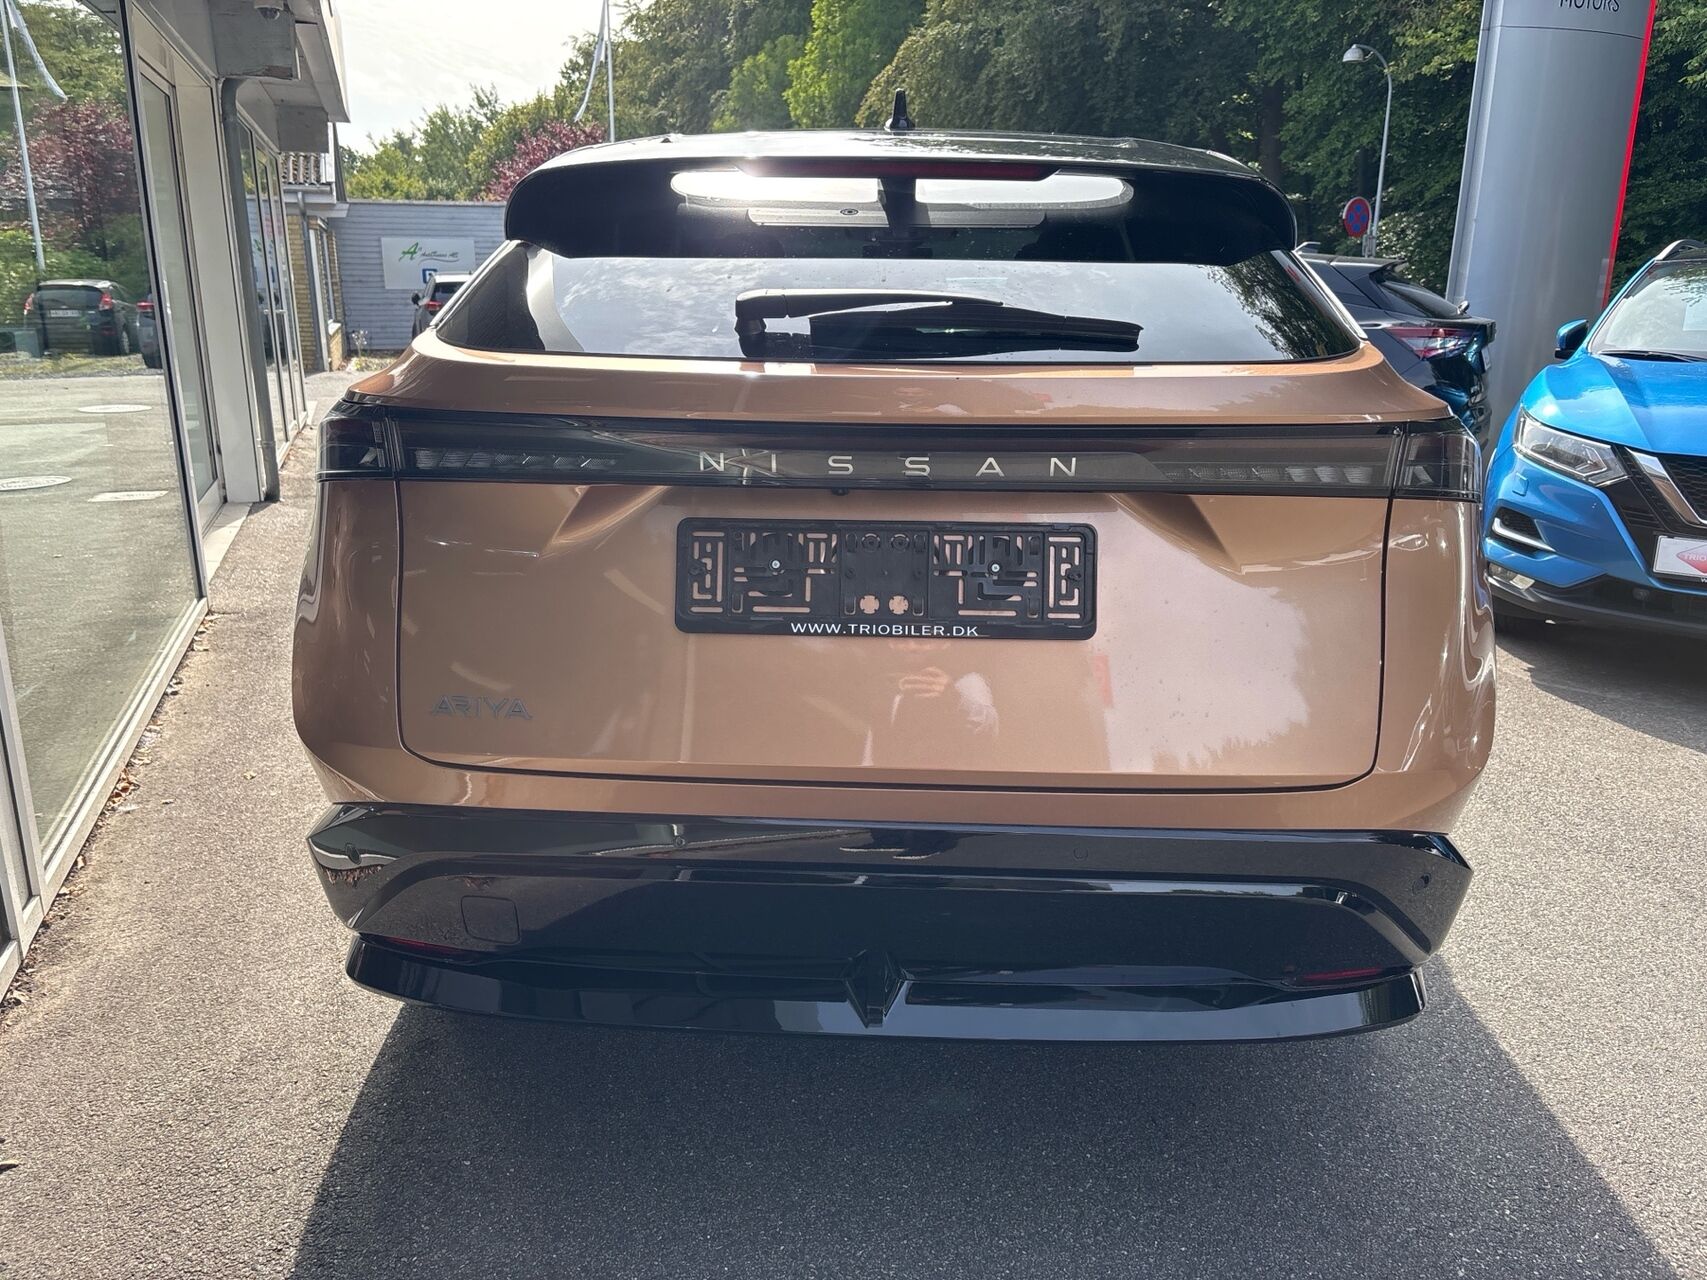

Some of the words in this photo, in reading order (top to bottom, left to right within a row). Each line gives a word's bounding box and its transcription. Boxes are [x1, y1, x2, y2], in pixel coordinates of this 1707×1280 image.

[700, 451, 1077, 477] NISSAN
[790, 622, 979, 637] WWW.TRIOBILER.DK
[432, 695, 533, 720] ARIYA
